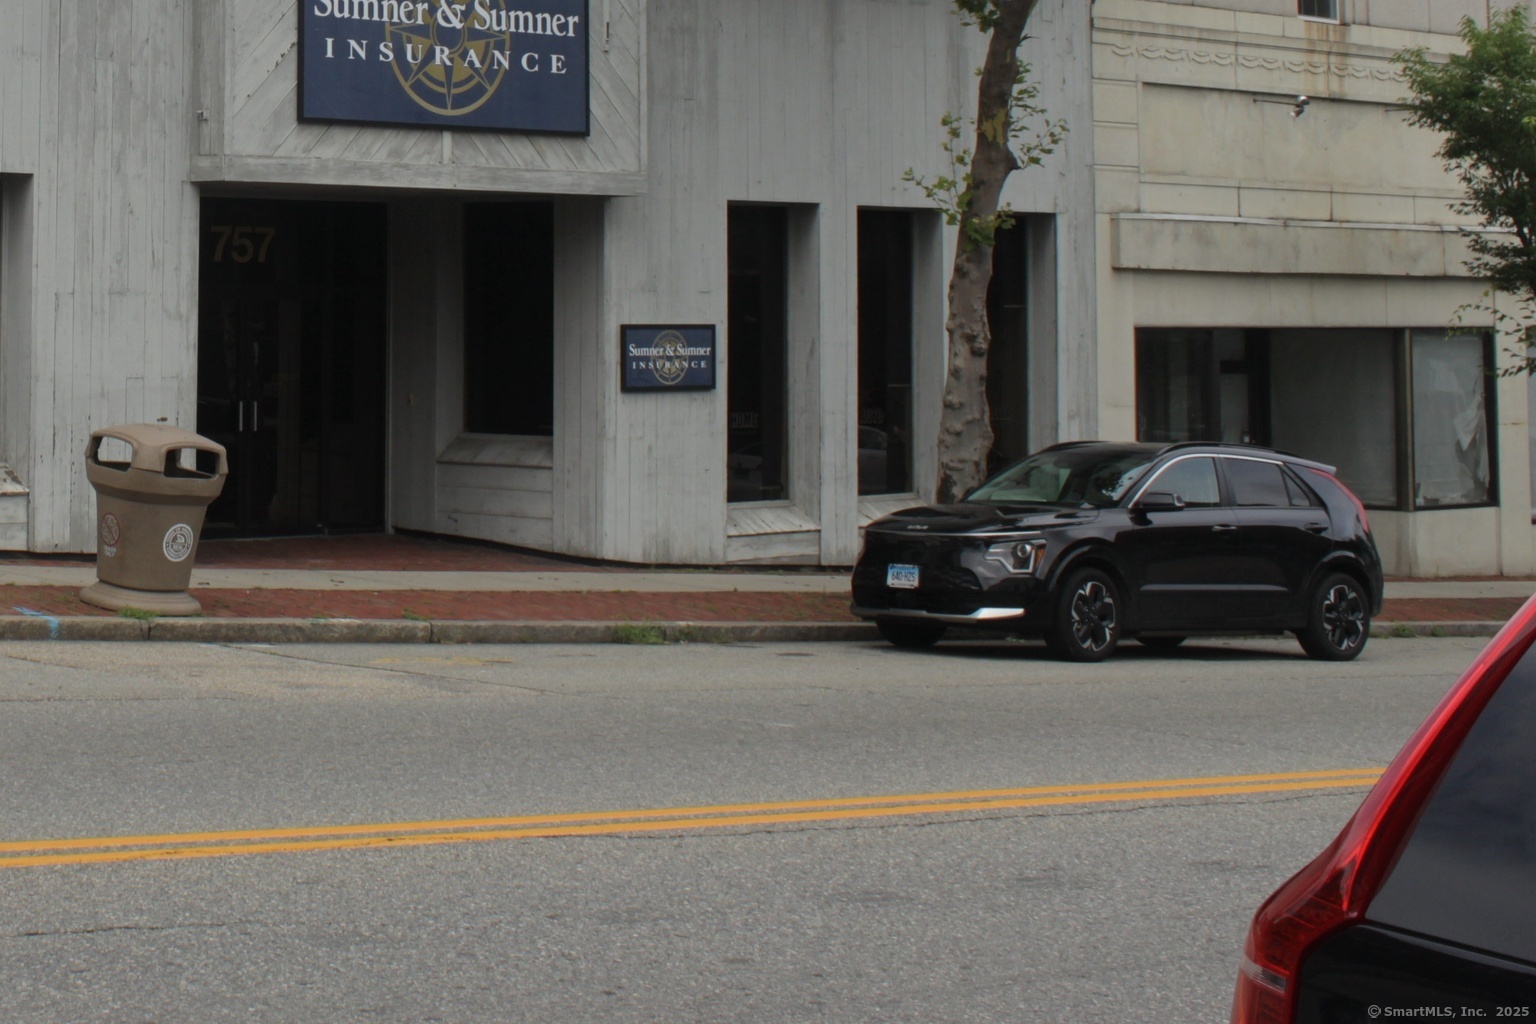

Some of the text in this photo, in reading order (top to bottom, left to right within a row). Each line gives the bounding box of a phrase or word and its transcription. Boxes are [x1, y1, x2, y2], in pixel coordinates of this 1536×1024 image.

[324, 37, 568, 75] INSURANCE
[210, 225, 277, 263] 757
[629, 343, 711, 356] Sumner & Sumner
[632, 360, 707, 370] INSURANCE
[730, 411, 759, 429] HOME
